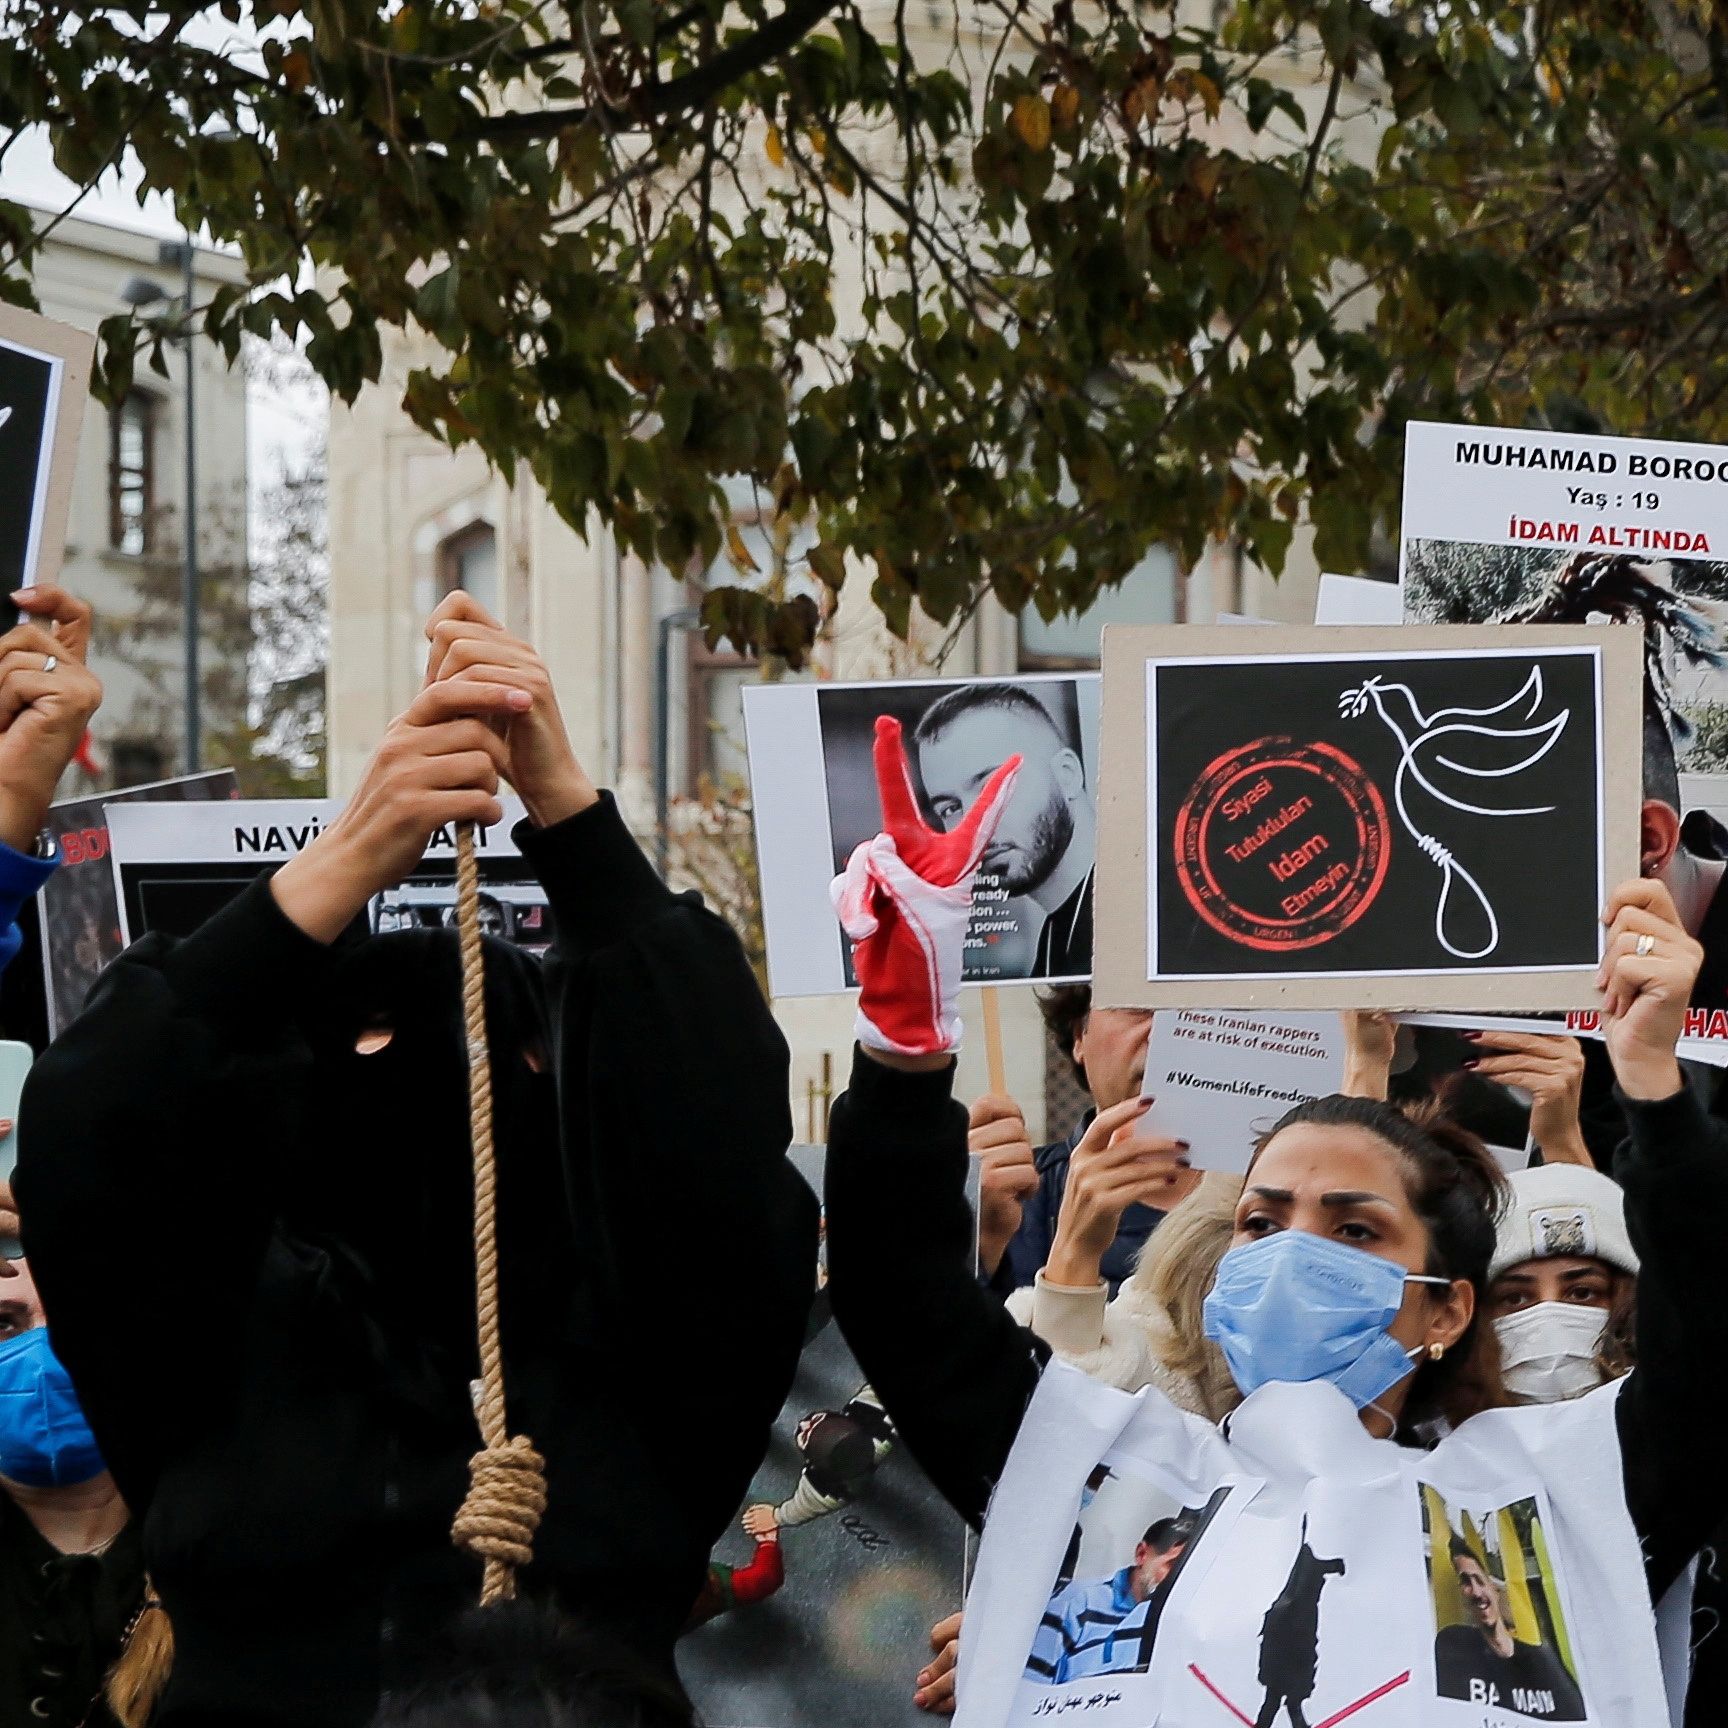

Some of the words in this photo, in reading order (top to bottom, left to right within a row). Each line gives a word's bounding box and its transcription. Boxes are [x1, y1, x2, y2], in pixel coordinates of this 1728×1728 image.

[1456, 442, 1617, 474] MUHAMAD
[1567, 487, 1608, 510] Yaş
[1632, 493, 1659, 510] 19
[1509, 515, 1579, 543] İDAM
[1588, 525, 1710, 552] ALTINDA
[1221, 775, 1273, 822] Siyasi
[235, 817, 326, 853] NAVİ
[1177, 1010, 1215, 1025] These
[1219, 1015, 1265, 1033] Iranian
[1270, 1026, 1320, 1041] rappers
[1174, 1026, 1195, 1039] are
[1199, 1031, 1212, 1041] at
[1216, 1034, 1240, 1046] risk
[1244, 1037, 1259, 1049] of
[1261, 1041, 1329, 1060] execution.
[1470, 1678, 1555, 1713] BAMAIN
